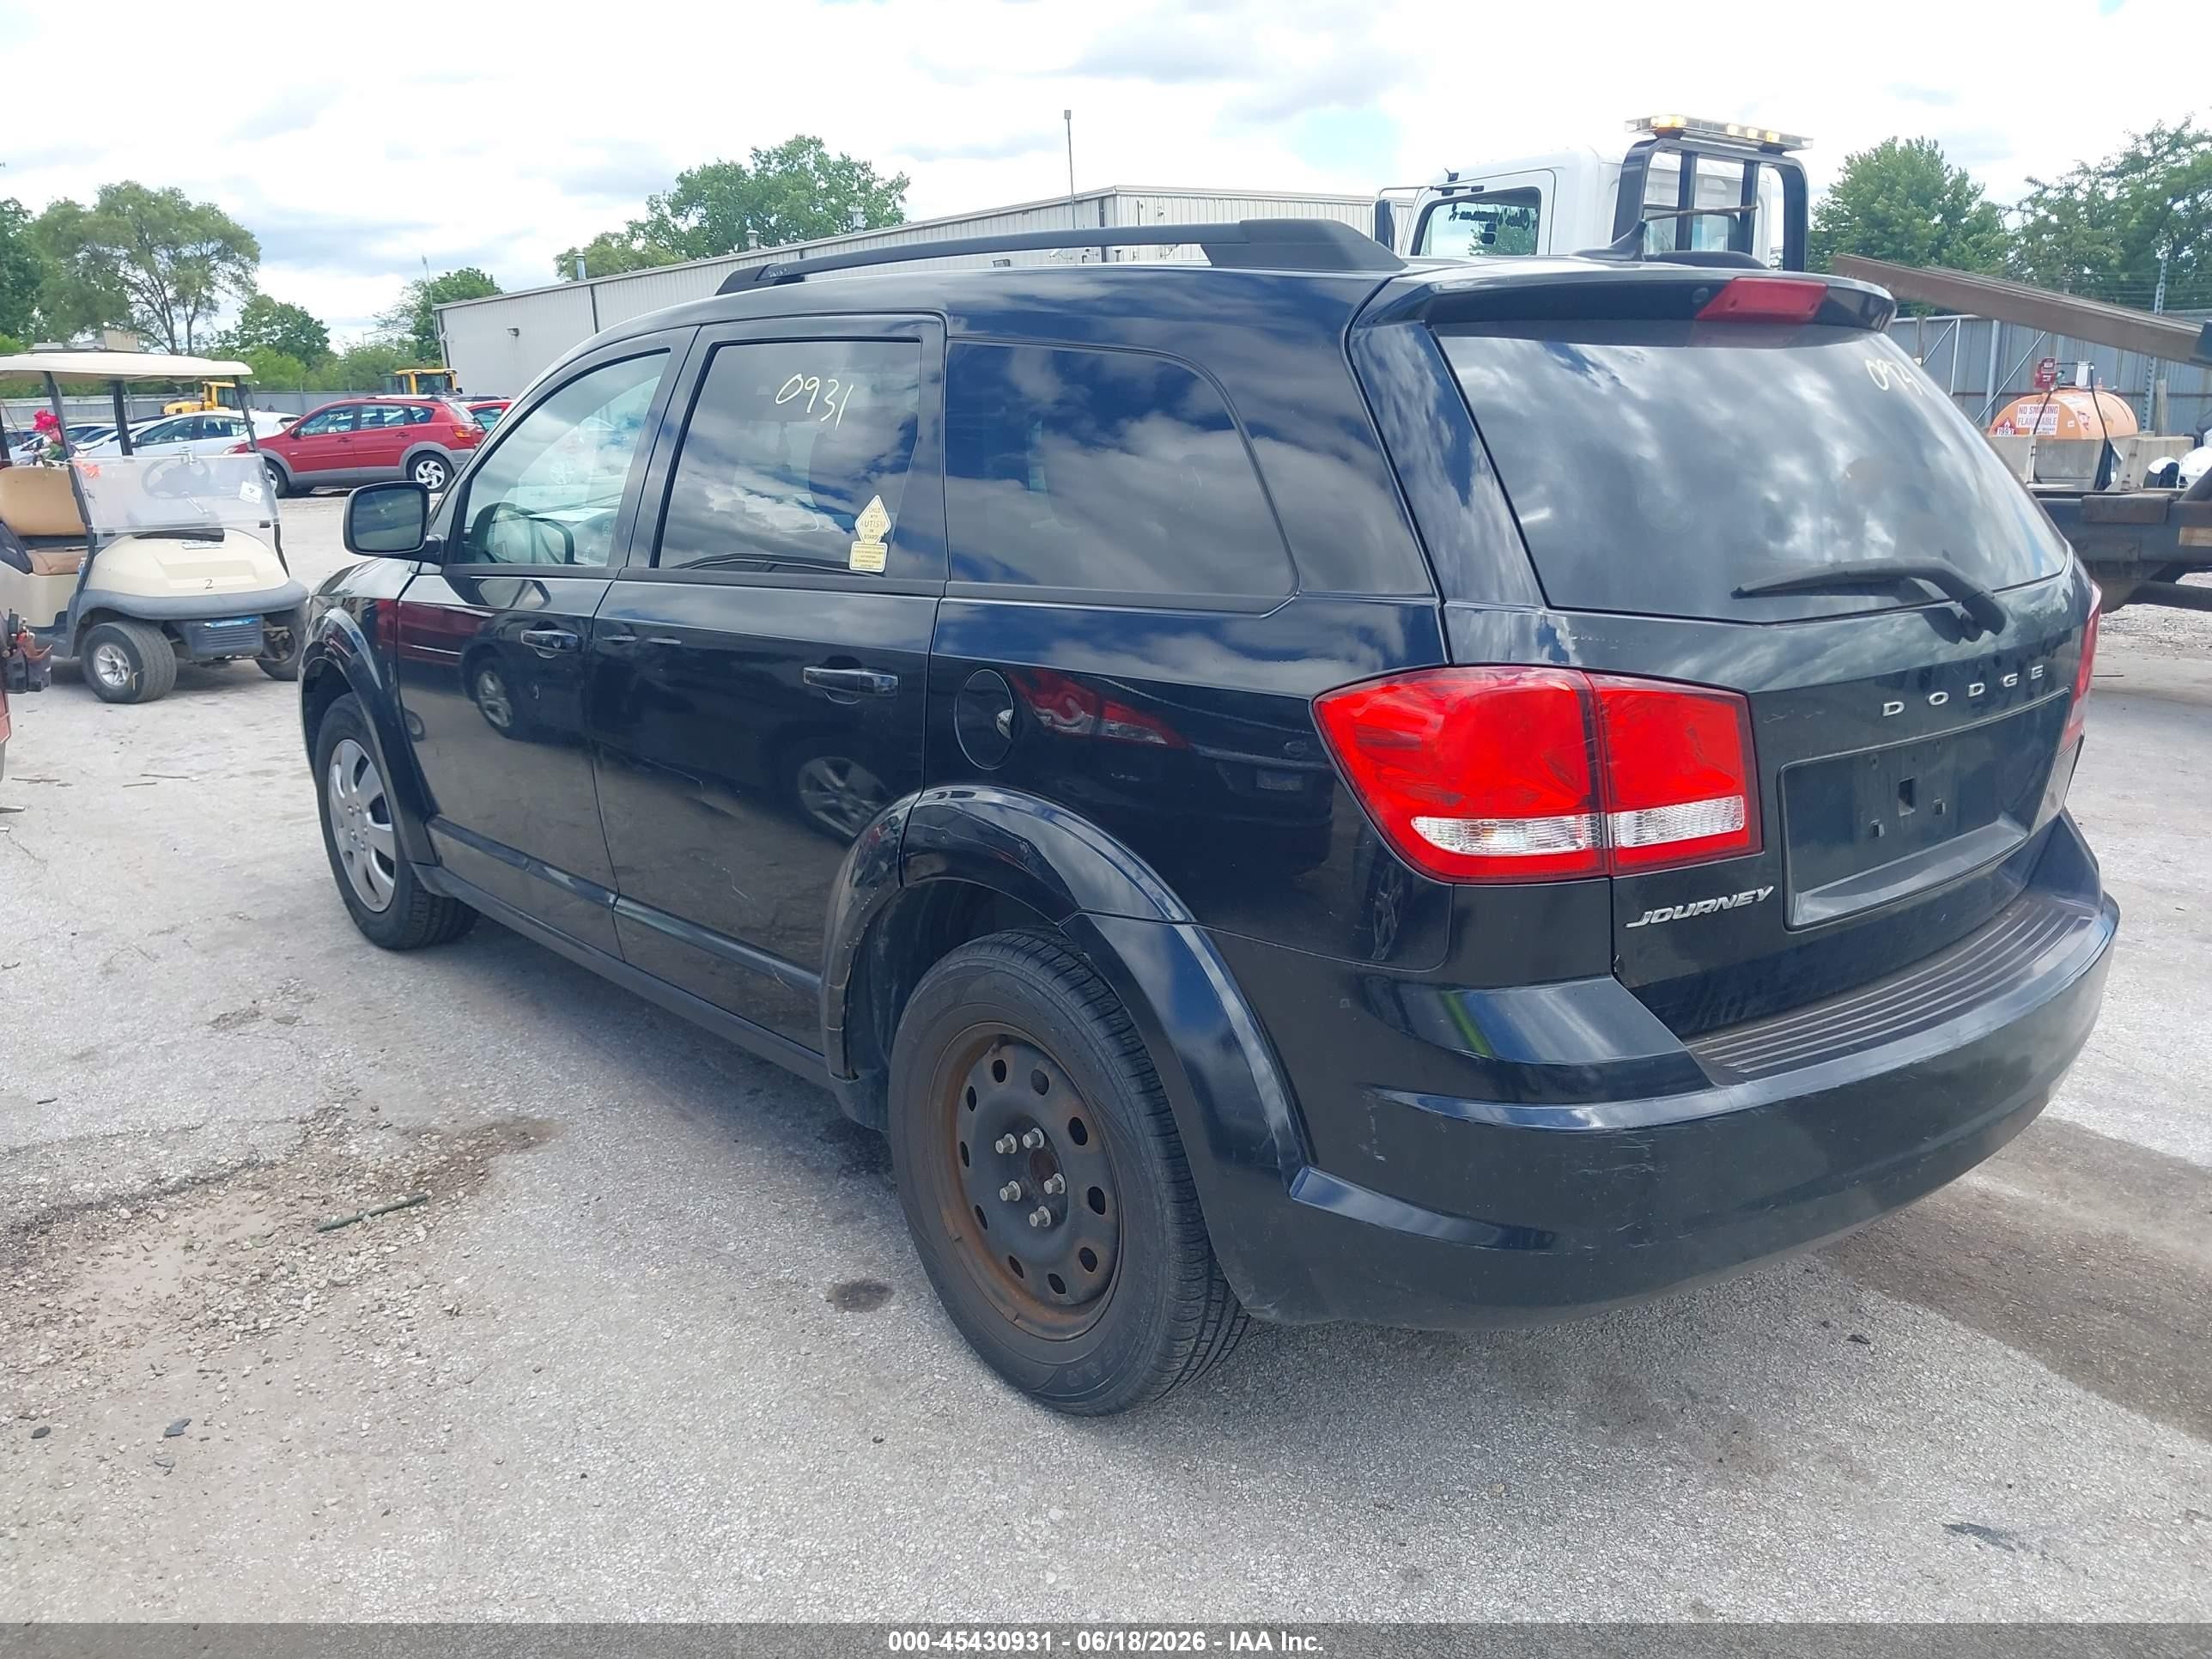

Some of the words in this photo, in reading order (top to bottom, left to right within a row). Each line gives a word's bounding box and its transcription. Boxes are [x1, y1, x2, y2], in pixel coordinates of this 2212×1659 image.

[775, 373, 854, 431] 0931
[2018, 405, 2027, 415] NO
[2018, 416, 2057, 426] FLAMABLE
[204, 578, 214, 590] 2
[1882, 665, 2044, 717] DODGE
[1626, 885, 1775, 928] JOURNEY
